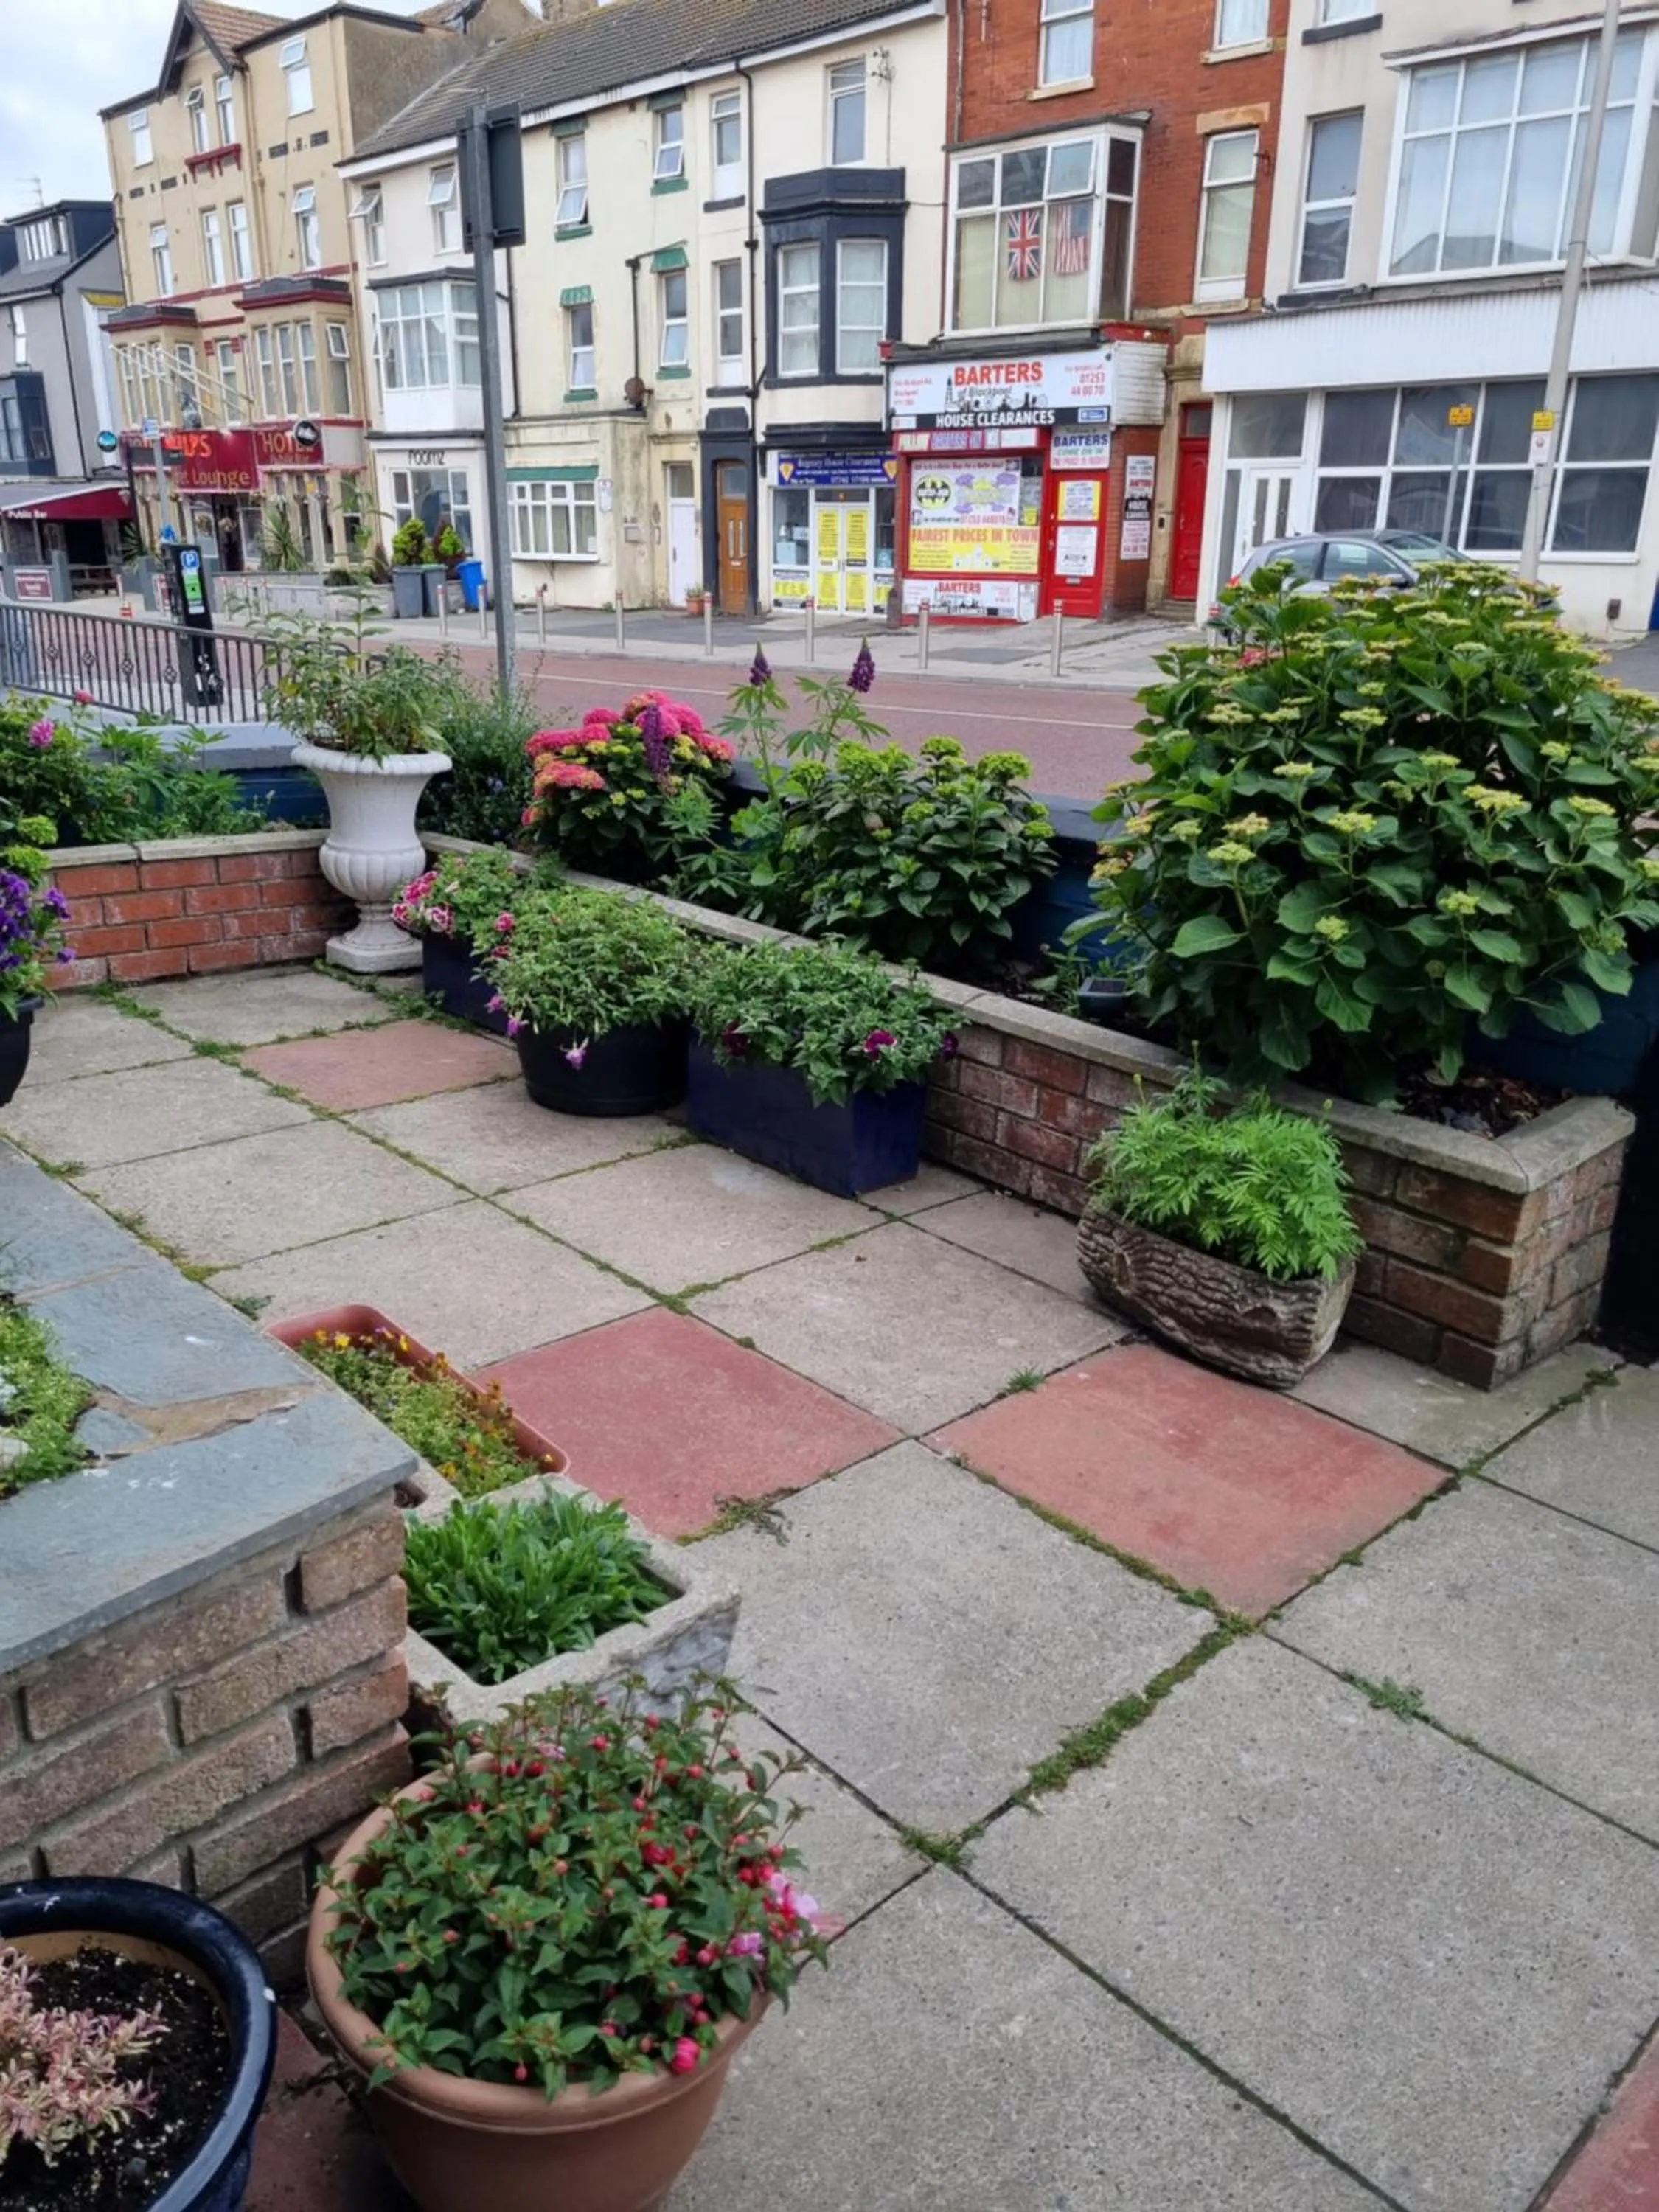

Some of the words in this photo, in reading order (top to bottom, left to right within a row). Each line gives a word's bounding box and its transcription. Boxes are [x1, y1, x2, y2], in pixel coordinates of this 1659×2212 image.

[954, 361, 1043, 386] BARTERS
[936, 412, 975, 428] HOUSE
[977, 409, 1056, 426] CLEARANCES
[261, 432, 315, 453] HOT
[1054, 434, 1109, 447] BARTERS
[192, 469, 250, 490] Lounge
[952, 528, 988, 543] PRICES
[991, 528, 1004, 542] IN
[1006, 527, 1039, 543] TOWN
[938, 582, 981, 594] BARTERS
